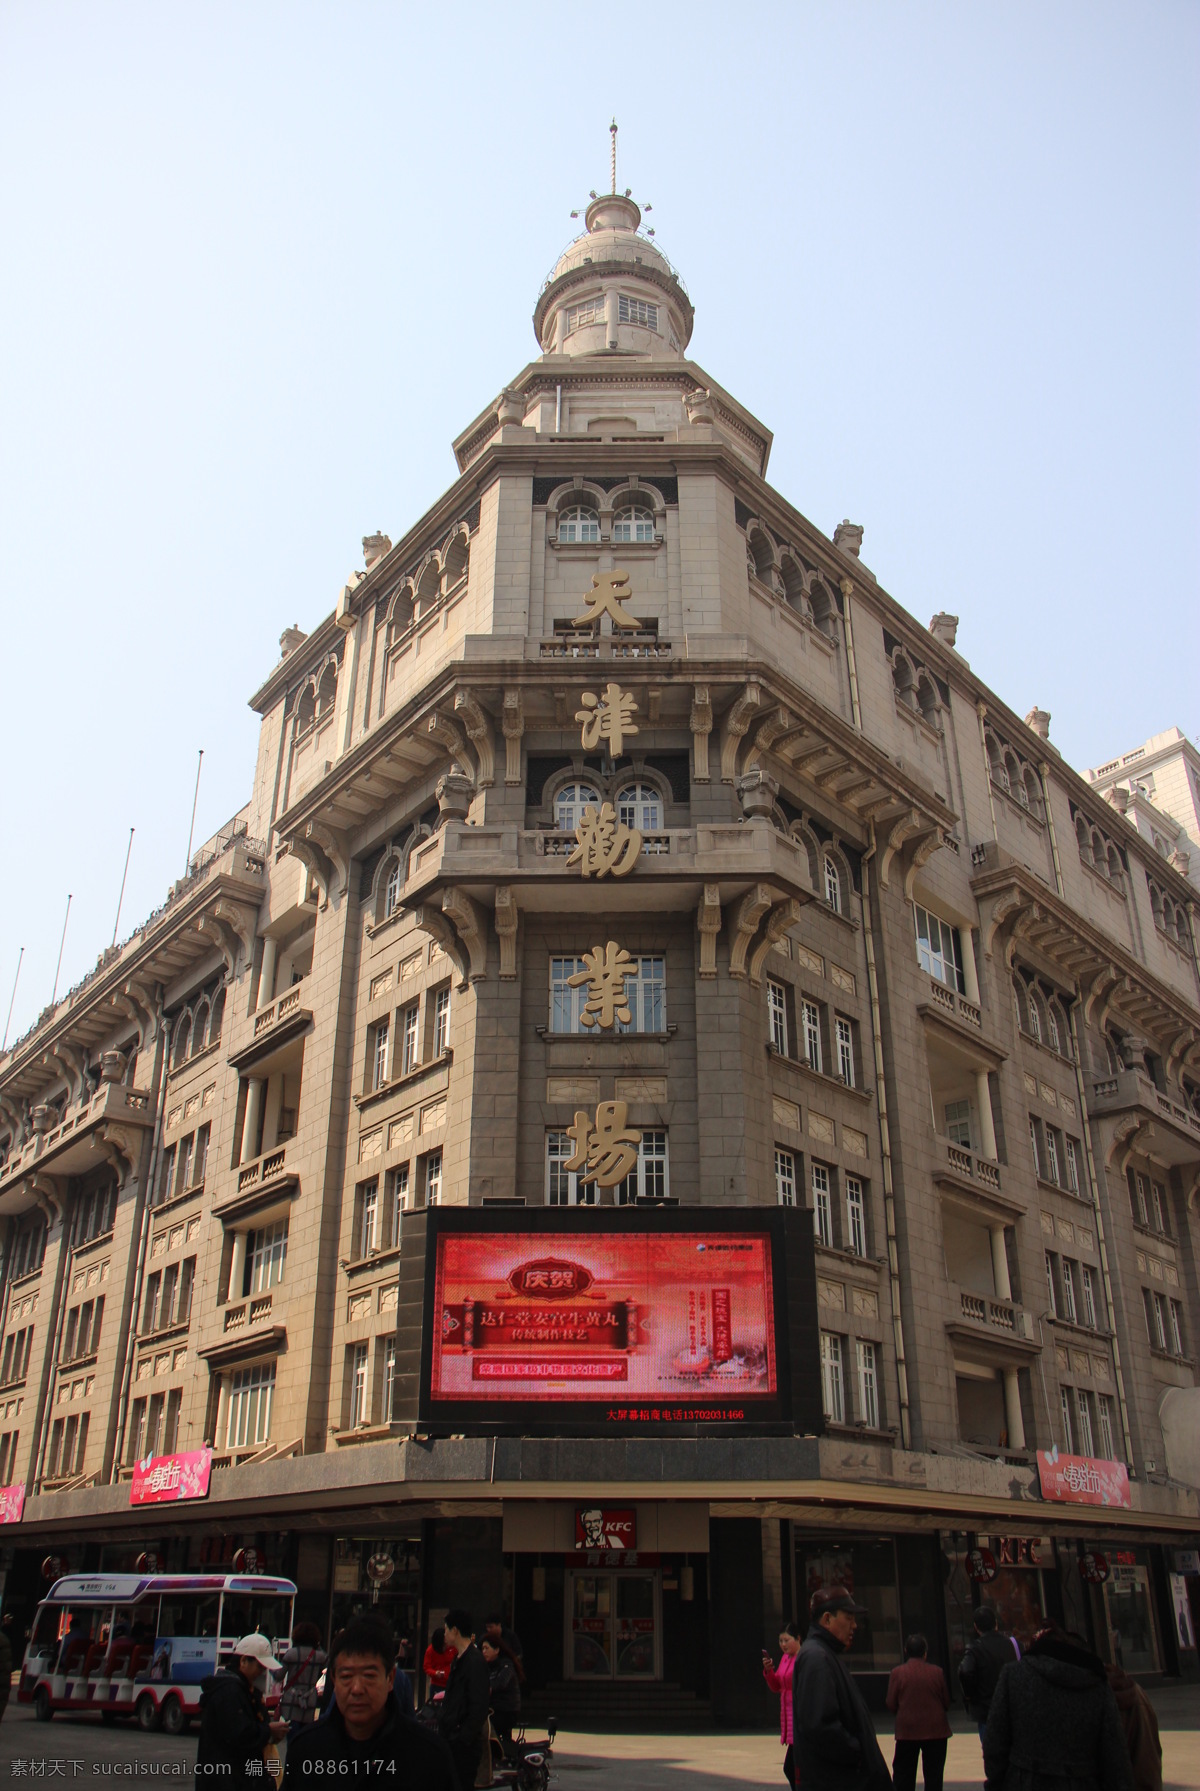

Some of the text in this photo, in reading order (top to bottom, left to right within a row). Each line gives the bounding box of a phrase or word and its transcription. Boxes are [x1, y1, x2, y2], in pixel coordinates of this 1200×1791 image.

[524, 1270, 575, 1289] 庆贺
[480, 1311, 619, 1327] 达仁堂安宫牛黄丸
[511, 1329, 588, 1341] 传统制作技艺
[605, 1521, 632, 1532] KFC
[1000, 1537, 1042, 1564] KFC
